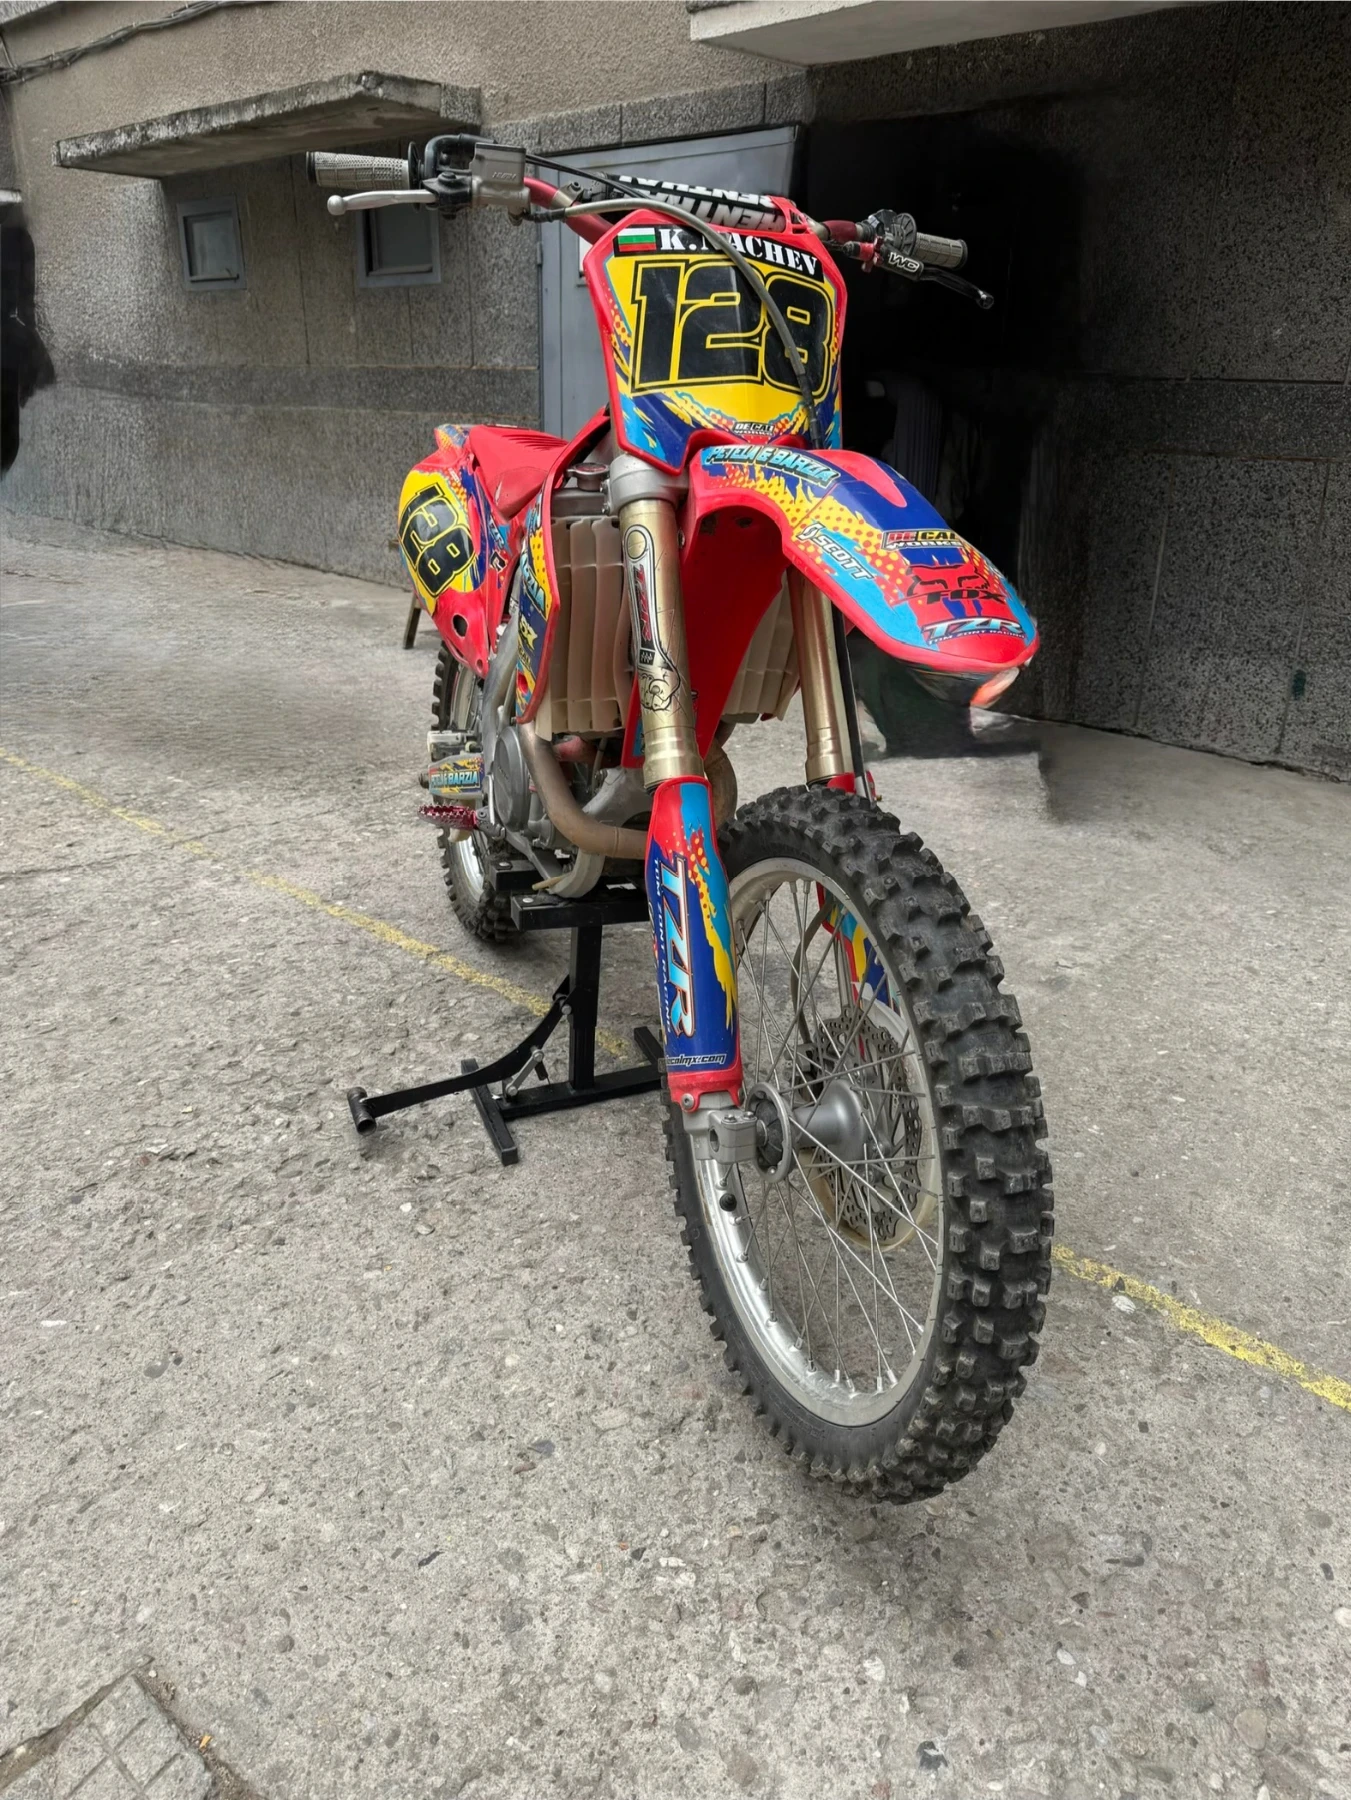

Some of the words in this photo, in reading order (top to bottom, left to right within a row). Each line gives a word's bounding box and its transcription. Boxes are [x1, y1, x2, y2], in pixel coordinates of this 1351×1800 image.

[630, 259, 838, 402] 128
[769, 450, 839, 486] BARZIA
[399, 483, 475, 598] 128
[810, 534, 875, 579] SCOTT
[926, 589, 1006, 604] FOX
[921, 617, 1024, 639] TZR
[661, 857, 694, 1037] TZR
